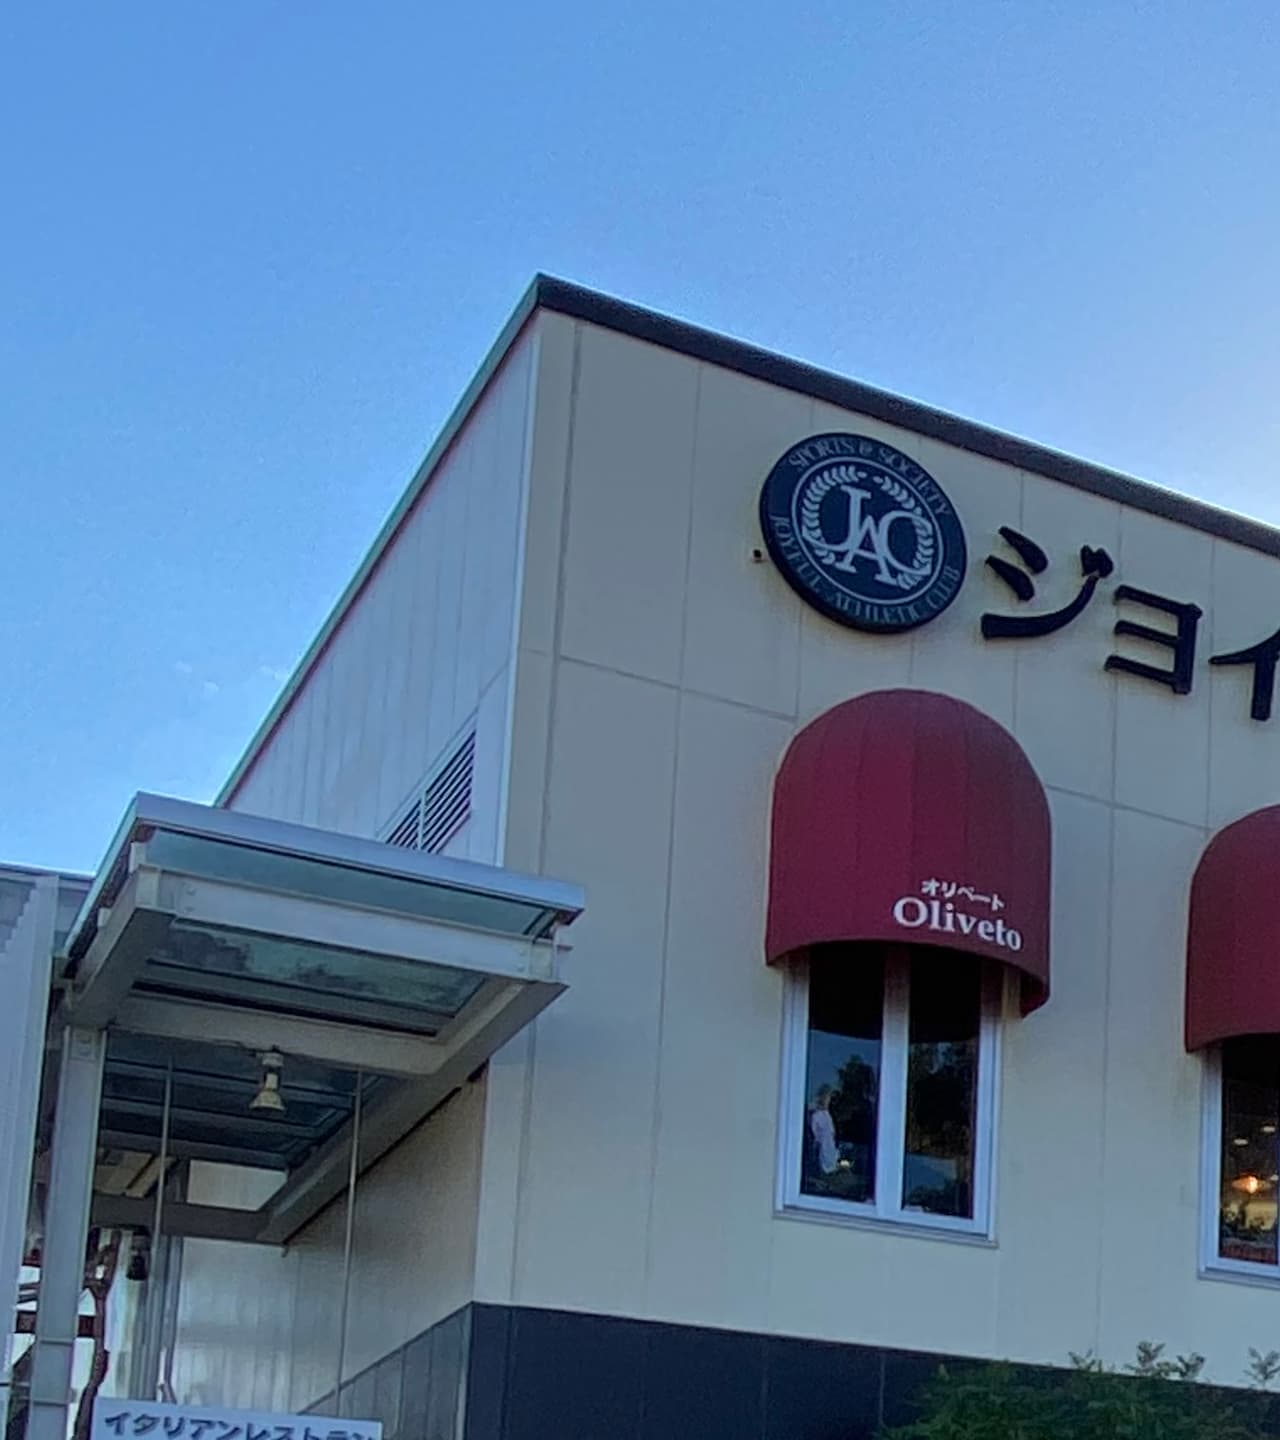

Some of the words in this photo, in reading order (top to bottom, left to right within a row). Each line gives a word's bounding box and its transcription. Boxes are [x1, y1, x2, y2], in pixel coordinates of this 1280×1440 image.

[921, 878, 1005, 911] オリベート
[893, 896, 1021, 951] Oliveto
